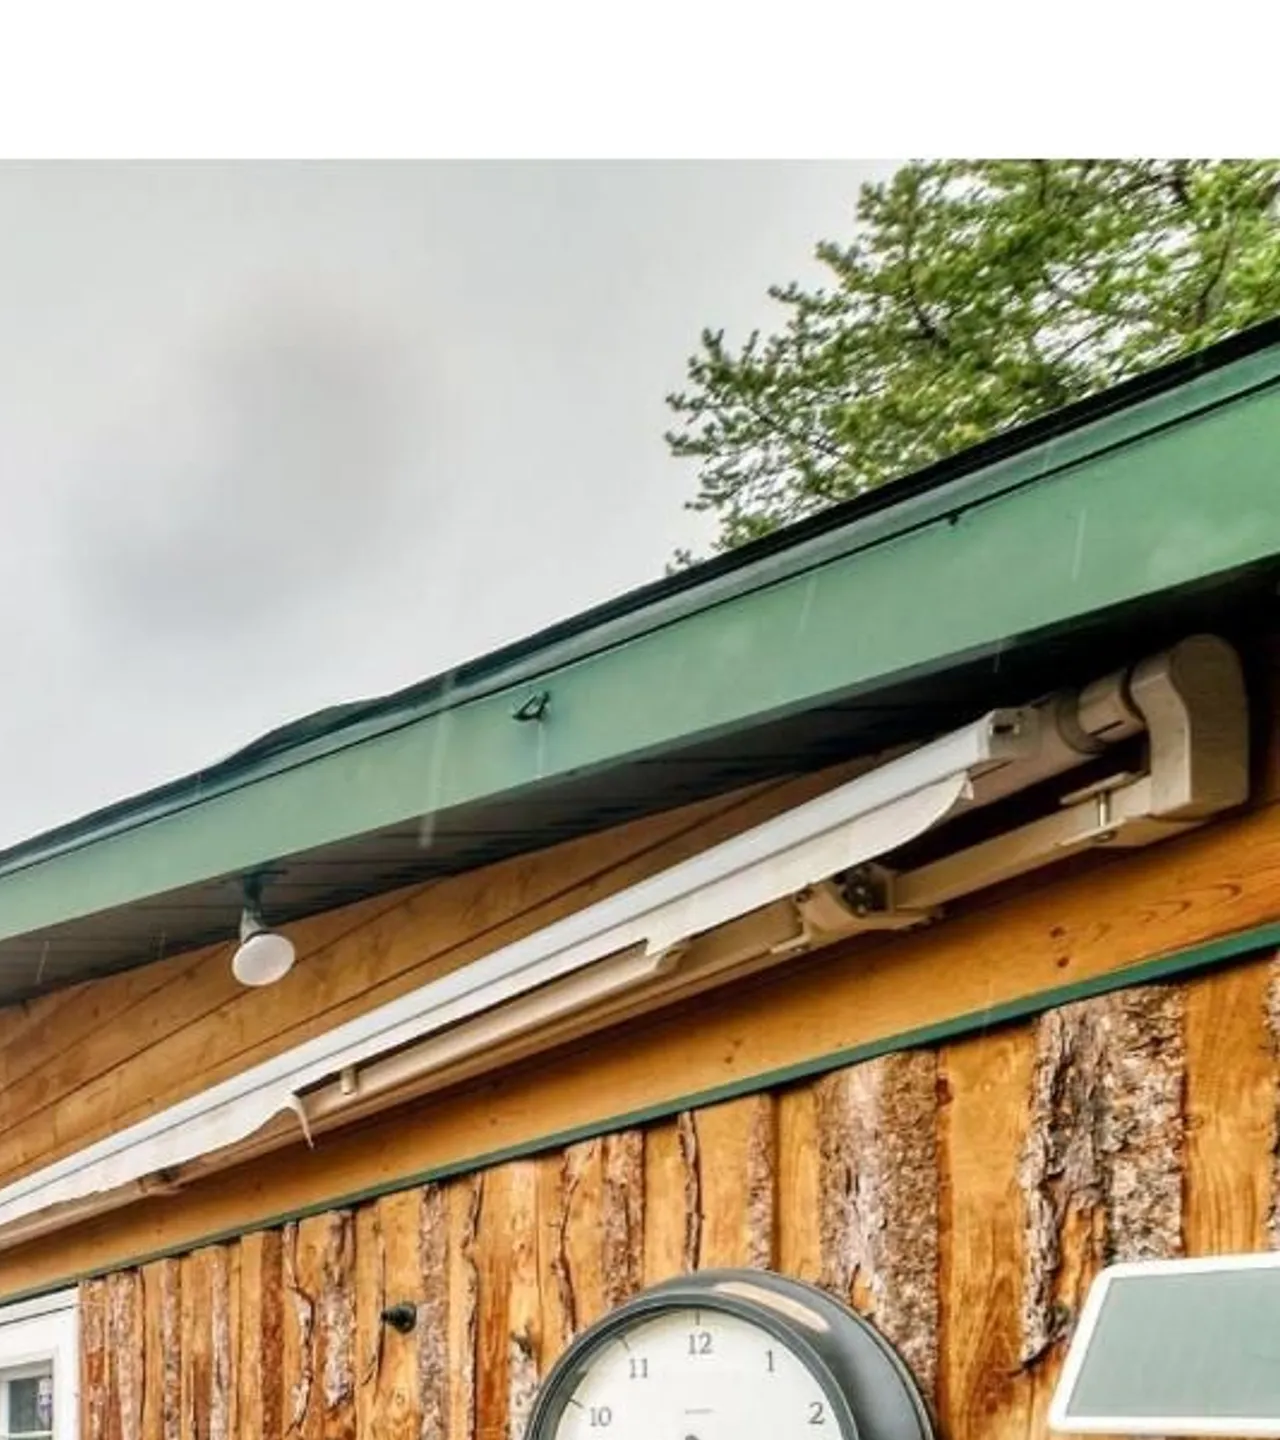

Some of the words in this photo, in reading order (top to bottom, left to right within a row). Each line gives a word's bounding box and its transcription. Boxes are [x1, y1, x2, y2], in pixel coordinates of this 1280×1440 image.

[688, 1331, 713, 1356] 12
[629, 1357, 649, 1380] 11
[765, 1348, 775, 1373] 1
[589, 1406, 613, 1428] 10
[807, 1401, 826, 1426] 2
